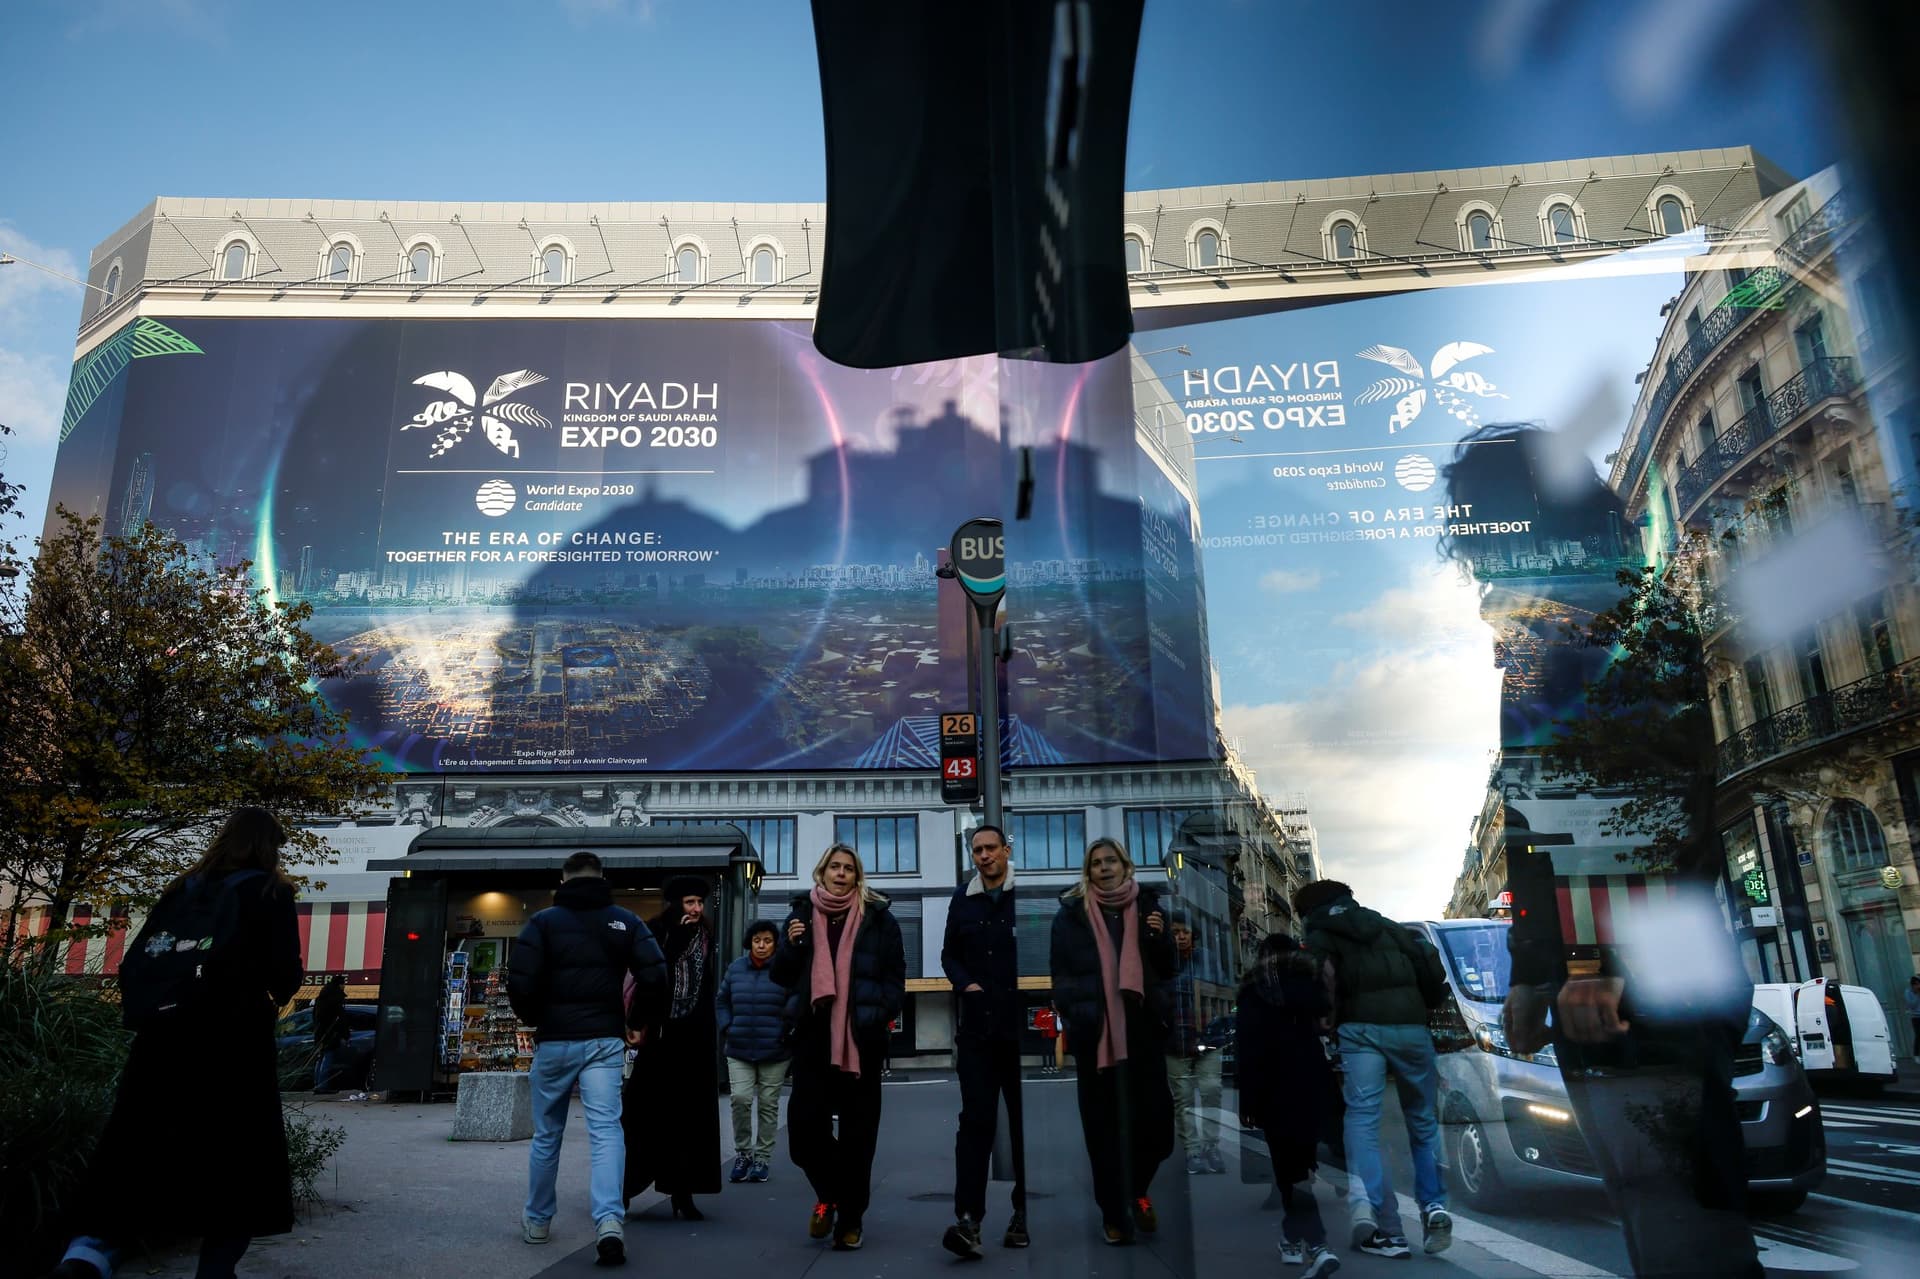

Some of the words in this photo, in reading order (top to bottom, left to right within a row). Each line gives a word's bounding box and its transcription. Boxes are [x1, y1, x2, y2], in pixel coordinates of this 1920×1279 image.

[564, 382, 718, 410] RIYADH
[563, 413, 617, 422] KINGDOM
[619, 413, 636, 422] OF
[638, 413, 672, 422] SAUDI
[675, 413, 718, 422] ARABIA
[561, 425, 642, 448] EXPO
[650, 426, 718, 448] 2030
[526, 484, 565, 496] World
[568, 484, 600, 498] Expo
[602, 484, 634, 496] 2030
[525, 499, 583, 512] Candidate
[442, 531, 481, 545] THE
[489, 531, 529, 545] ERA
[537, 531, 564, 545] OF
[571, 531, 662, 545] CHANGE:
[386, 551, 467, 562] TOGETHER
[470, 551, 501, 562] FOR
[503, 551, 514, 562] A
[518, 551, 622, 562] FORESIGHTED
[946, 716, 971, 734] 26
[558, 749, 575, 757] 2030
[517, 758, 553, 767] Ensemble
[582, 757, 606, 765] Avenir
[607, 757, 648, 766] Clairvoyant
[947, 759, 972, 777] 43
